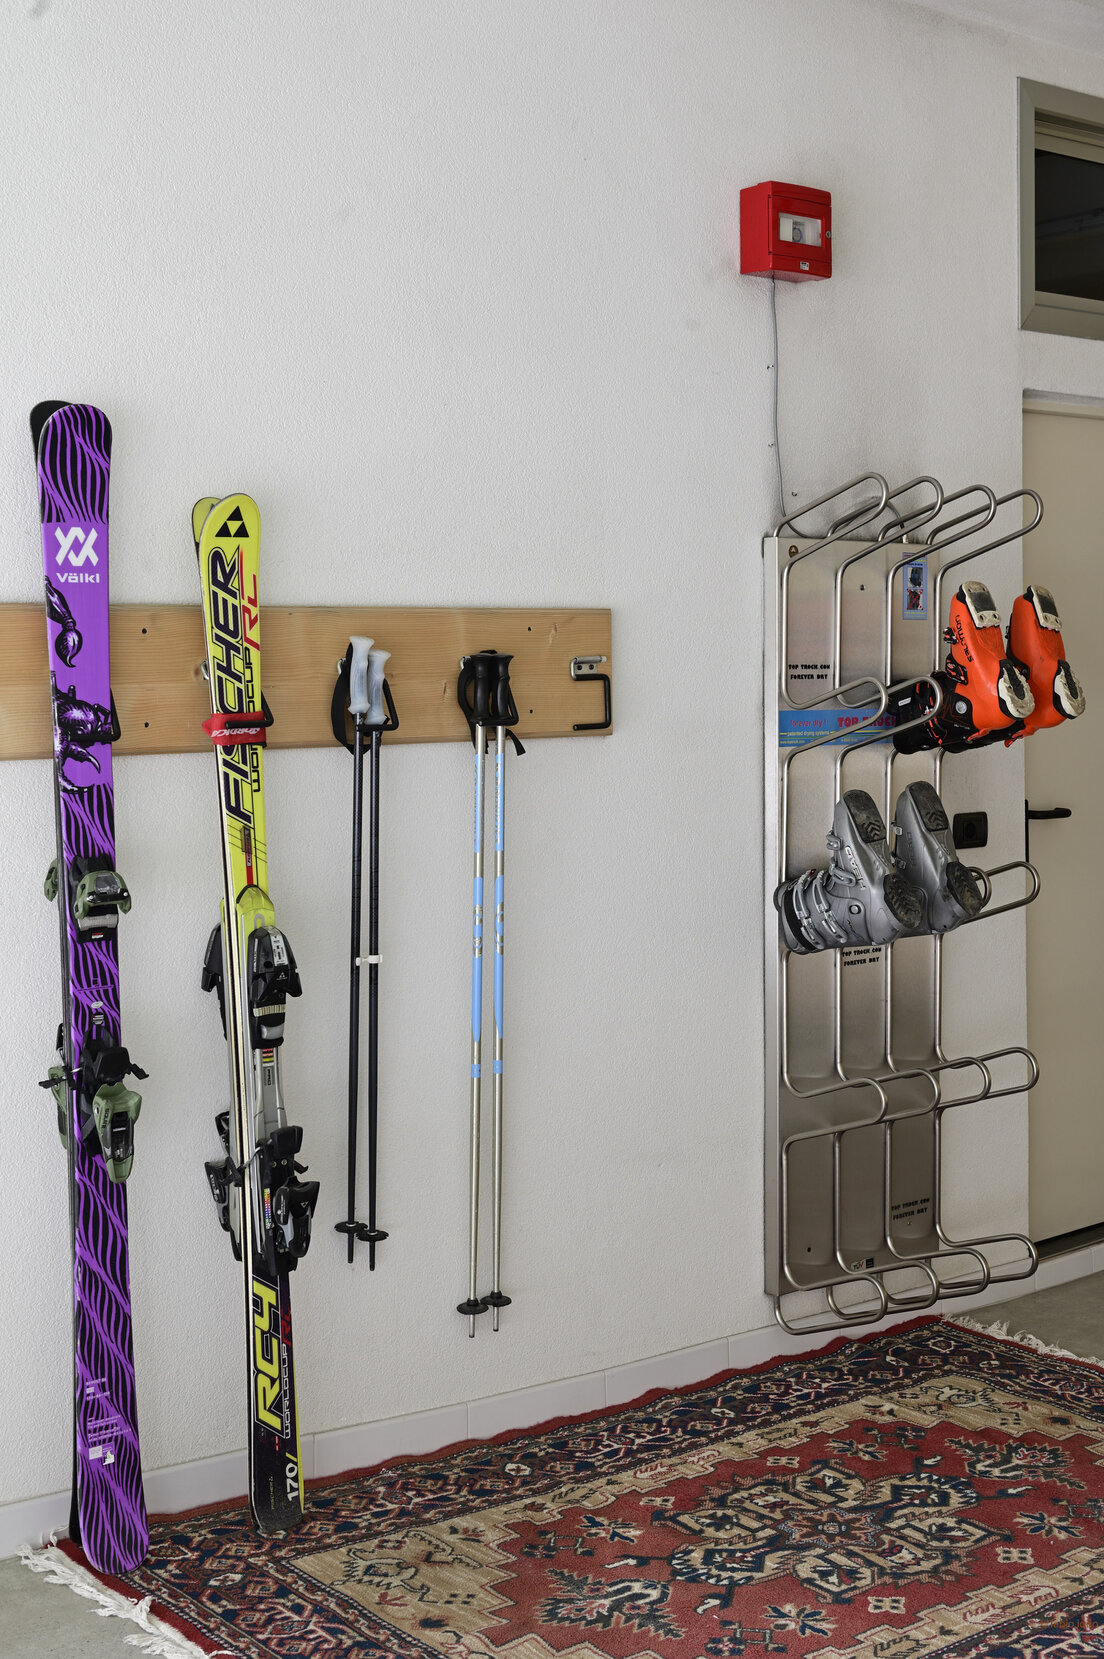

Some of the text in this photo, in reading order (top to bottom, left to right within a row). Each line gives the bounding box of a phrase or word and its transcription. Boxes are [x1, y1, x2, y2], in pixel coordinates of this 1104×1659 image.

[56, 572, 100, 583] Völkl
[244, 646, 260, 792] WORDCUP
[837, 716, 859, 728] TOP
[843, 959, 867, 967] FOREVER
[253, 1280, 282, 1431] RC4
[281, 1343, 292, 1439] WORLDCUP
